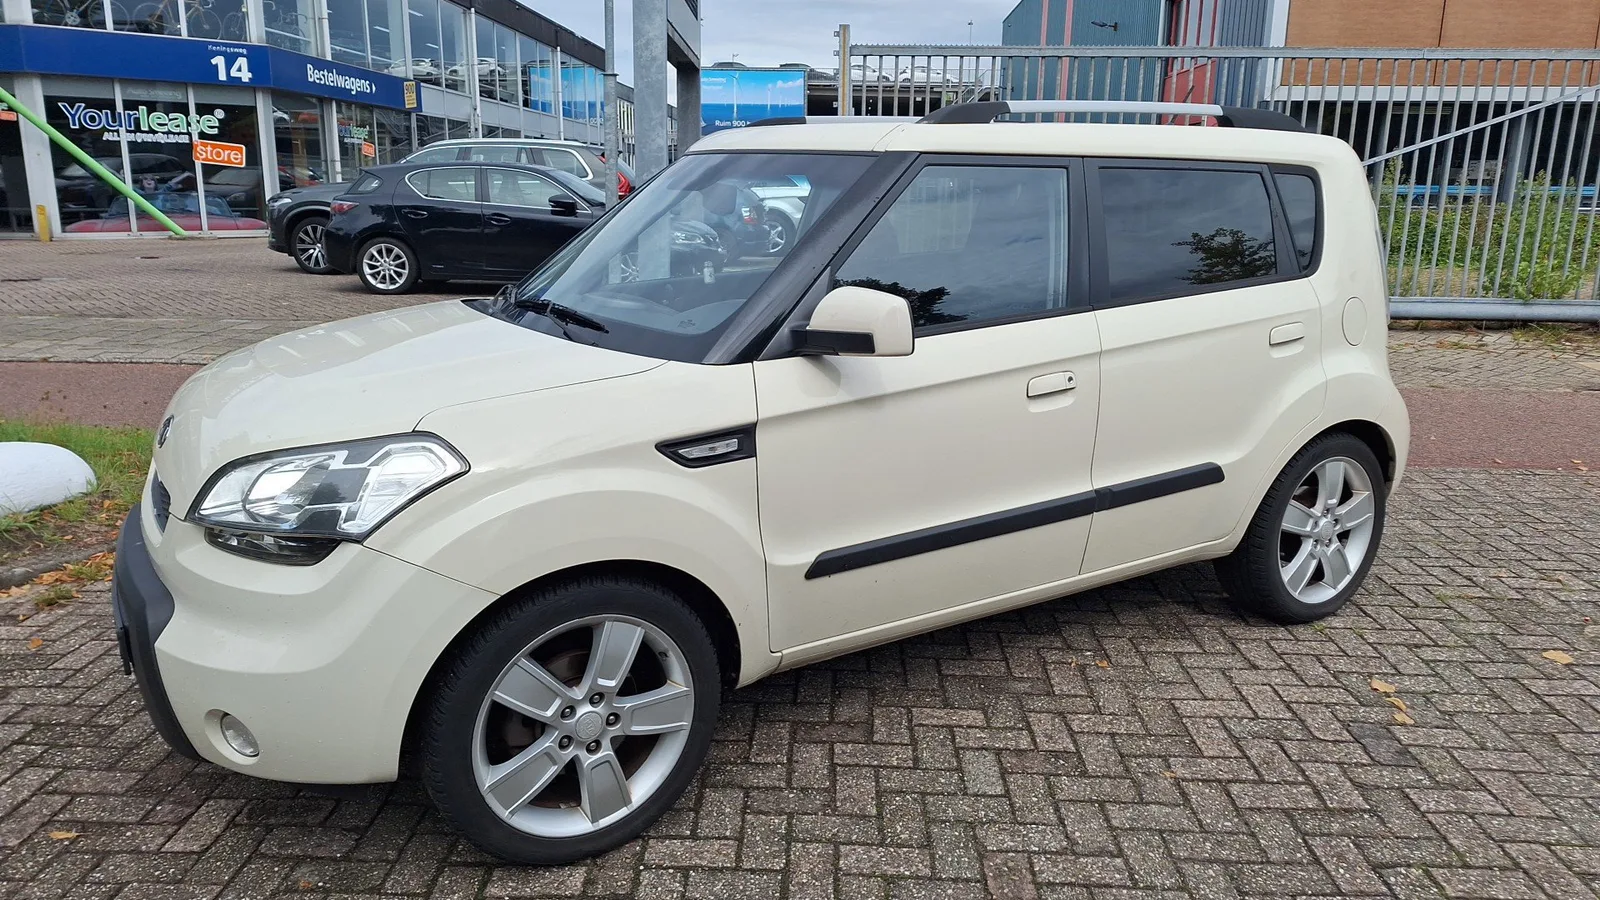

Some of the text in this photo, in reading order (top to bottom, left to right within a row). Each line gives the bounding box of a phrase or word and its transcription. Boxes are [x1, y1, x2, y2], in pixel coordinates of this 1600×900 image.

[210, 55, 253, 82] 14
[306, 63, 371, 95] Bestelwagens
[195, 143, 243, 164] store
